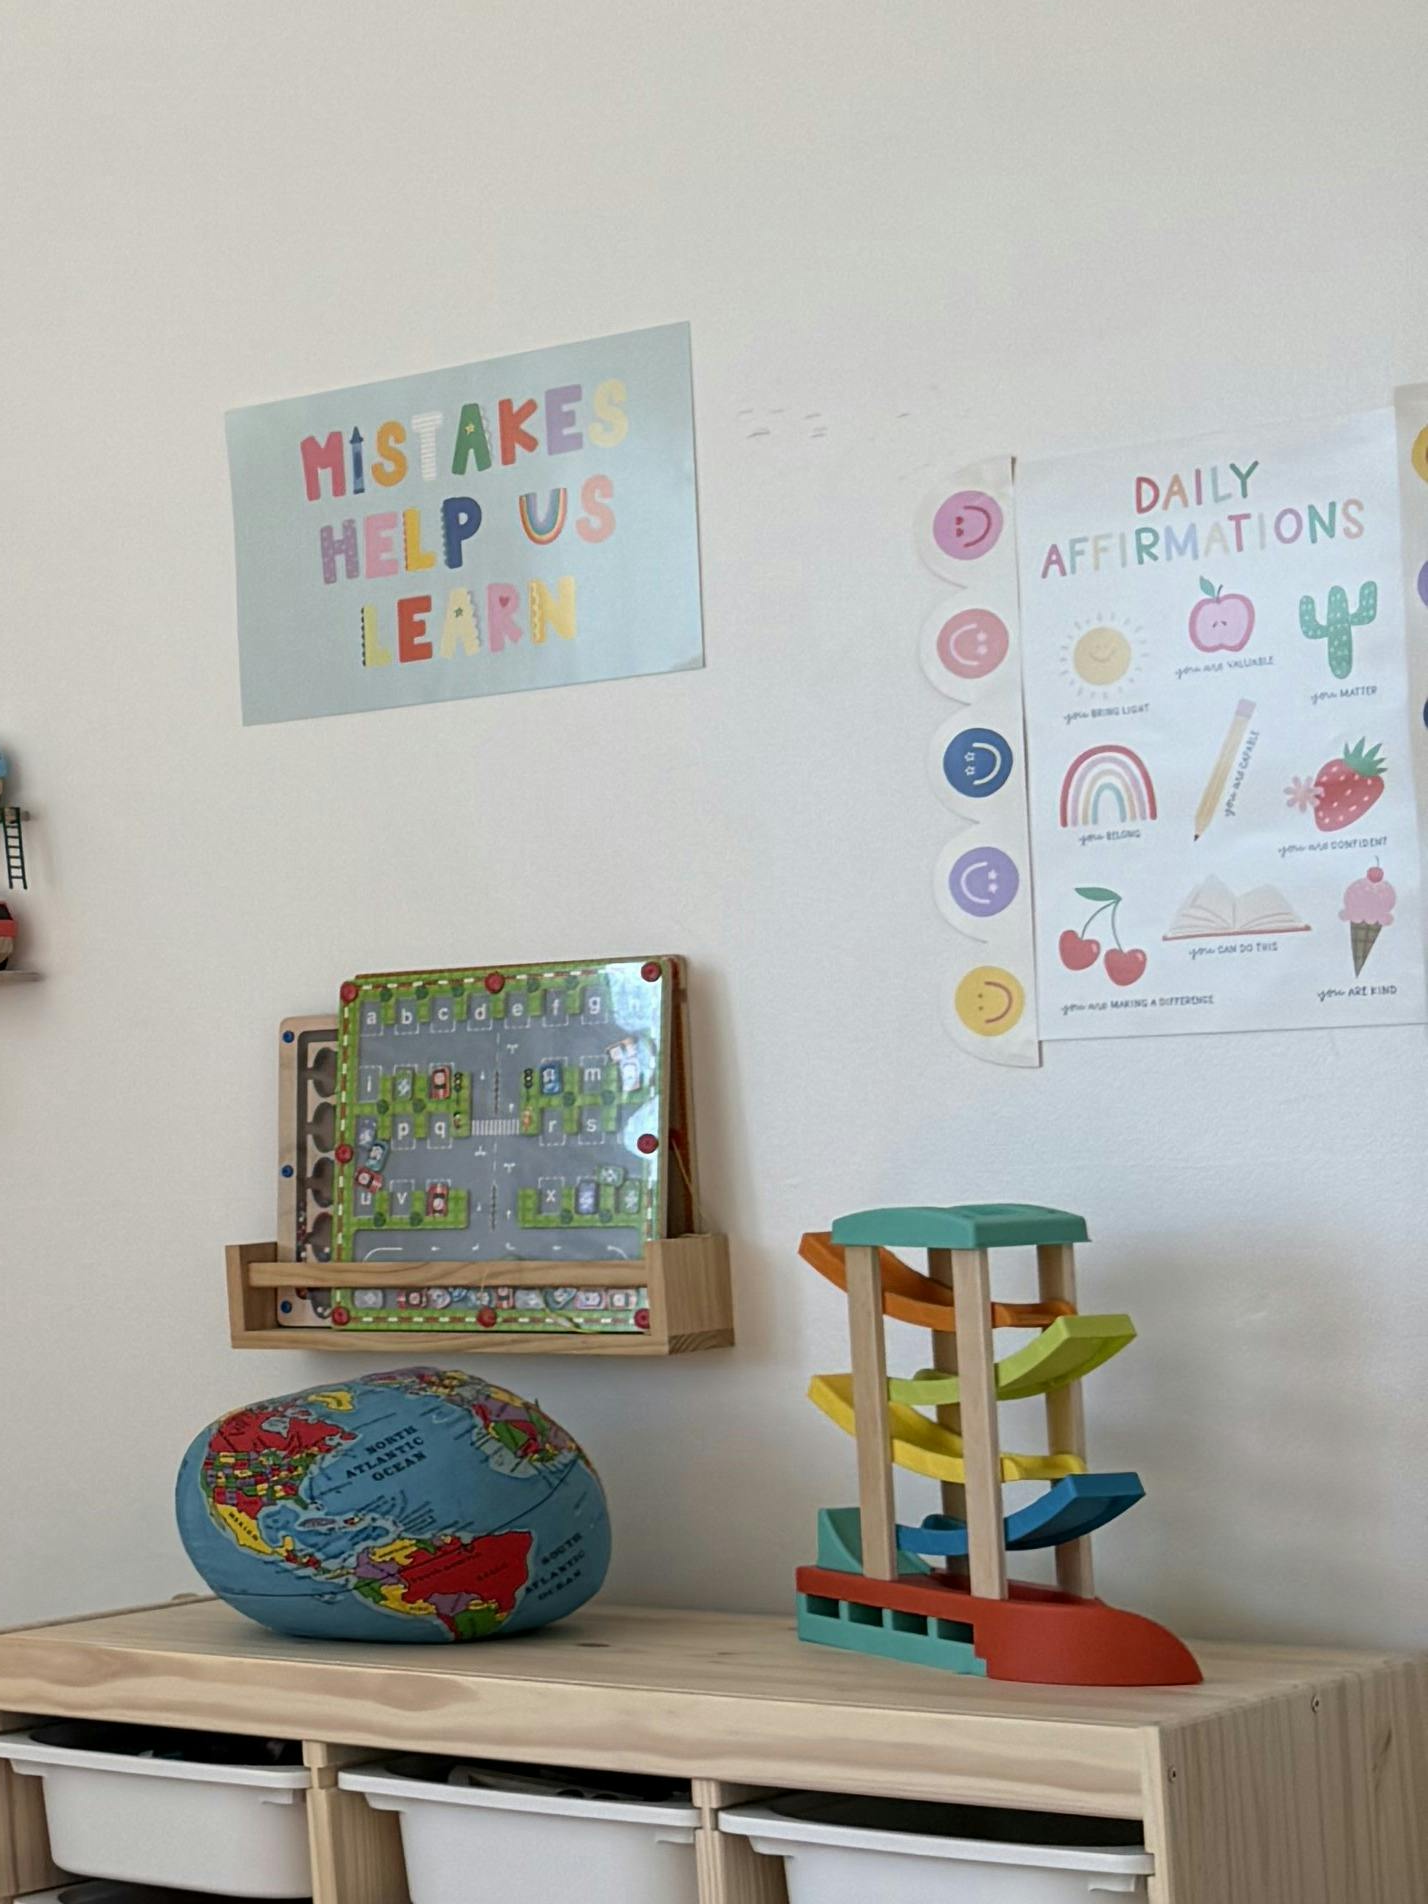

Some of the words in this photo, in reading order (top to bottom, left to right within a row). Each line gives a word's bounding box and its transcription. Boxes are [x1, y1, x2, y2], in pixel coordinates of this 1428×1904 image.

[300, 379, 629, 501] MISTAKES
[1135, 460, 1259, 514] DAILY
[319, 497, 482, 585] HELP
[518, 474, 616, 545] US
[1041, 499, 1364, 579] AFFIRMATIONS
[361, 576, 576, 667] LEARN
[1175, 666, 1201, 680] you
[1310, 691, 1337, 705] you
[1340, 685, 1378, 698] MATTER
[1064, 712, 1089, 725] you
[1122, 703, 1149, 715] LIGHT
[1224, 791, 1236, 817] you
[1079, 834, 1104, 846] you
[1106, 829, 1141, 841] BELONG
[1278, 845, 1305, 858] you
[1330, 836, 1387, 850] CONFIDENT
[1189, 947, 1215, 960] you
[1217, 943, 1237, 954] CAN
[1240, 944, 1253, 953] DO
[1256, 942, 1278, 952] THIS
[1318, 989, 1345, 1002] you
[1370, 984, 1397, 996] KIND
[366, 1011, 377, 1025] a
[401, 1008, 413, 1024] b
[438, 1007, 449, 1021] c
[474, 1003, 487, 1020] d
[512, 1003, 523, 1016] e
[552, 999, 560, 1016] f
[588, 996, 601, 1014] g
[1061, 1004, 1085, 1016] you
[1110, 998, 1148, 1009] MAKING
[1158, 995, 1214, 1007] DIFFERENCE
[584, 1067, 601, 1081] m
[398, 1121, 409, 1140] p
[434, 1121, 446, 1139] q
[548, 1120, 557, 1133] r
[586, 1119, 597, 1132] s
[397, 1192, 407, 1204] v
[546, 1190, 556, 1202] x
[365, 1425, 418, 1454] NORTH
[346, 1436, 424, 1479] ATLANTIC
[372, 1451, 427, 1481] OCEAN
